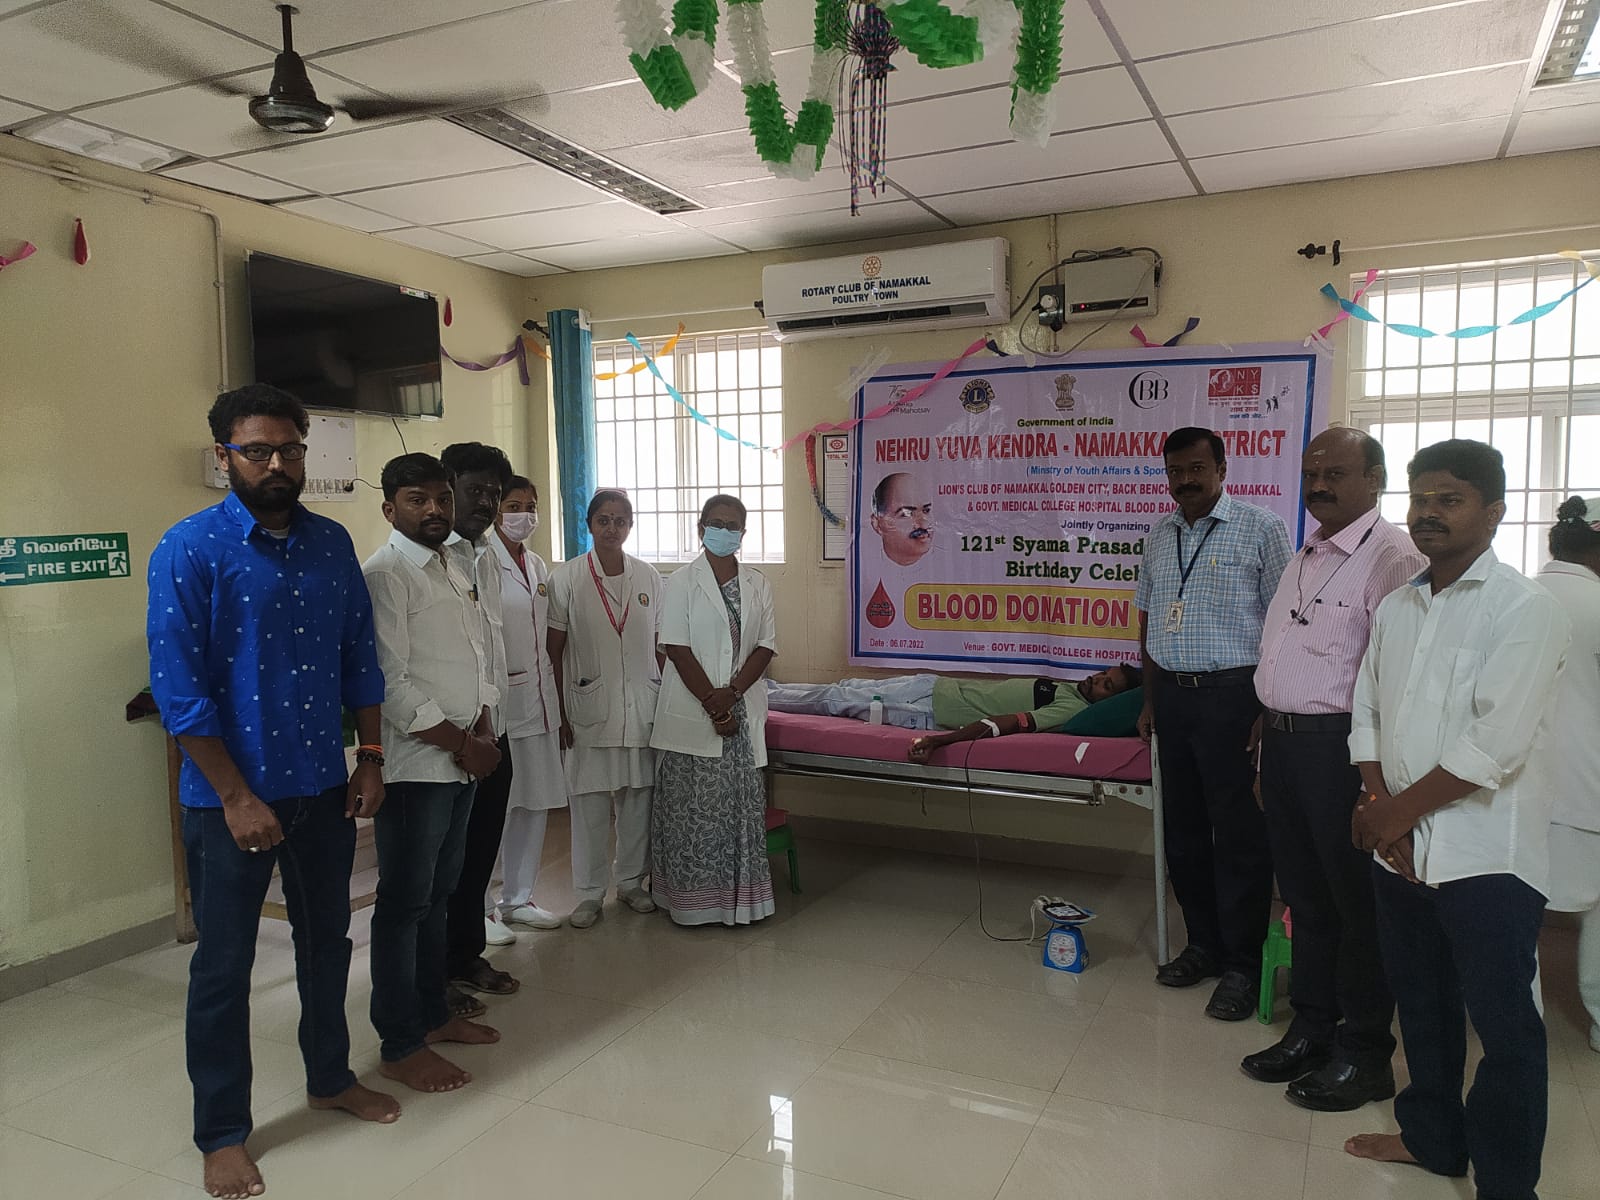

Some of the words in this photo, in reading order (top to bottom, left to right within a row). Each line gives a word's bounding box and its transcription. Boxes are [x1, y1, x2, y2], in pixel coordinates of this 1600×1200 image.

[801, 286, 836, 298] ROTARY
[837, 282, 861, 294] CLUB
[879, 276, 931, 290] NAMAKKAL
[832, 293, 869, 305] POULTRY
[873, 291, 899, 300] TOWN
[1017, 418, 1074, 427] Government
[1077, 417, 1087, 426] of
[1089, 416, 1114, 426] India
[876, 437, 930, 462] NEHRU
[935, 436, 982, 460] YUVA
[987, 432, 1058, 459] KENDRA
[1074, 431, 1168, 457] NAMAKKA
[1064, 466, 1073, 475] of
[1075, 466, 1100, 475] Youth
[1102, 466, 1131, 475] Affairs
[1134, 466, 1140, 475] &
[938, 484, 964, 495] LION'S
[967, 484, 988, 495] CLUB
[990, 484, 1001, 494] OF
[1004, 483, 1049, 494] NAMAKKAL
[1050, 483, 1085, 493] GOLDEN
[1087, 483, 1110, 496] CITY,
[1112, 484, 1136, 494] BACK
[1226, 484, 1282, 496] NAMAKKAL
[967, 501, 973, 511] &
[975, 501, 999, 511] GOVT.
[1001, 501, 1039, 511] MEDICAL
[1041, 501, 1075, 511] COLLEGE
[1078, 502, 1122, 512] HOSPITAL
[1125, 502, 1156, 513] BLOOD
[1061, 520, 1094, 531] Jointly
[1096, 521, 1150, 533] Organizing
[23, 537, 118, 554] வெளியே
[1013, 536, 1070, 556] Syama
[1077, 537, 1145, 555] Prasad
[28, 562, 66, 576] FIRE
[71, 559, 107, 573] EXIT
[1005, 561, 1082, 583] Birthday
[918, 593, 997, 620] BLOOD
[1006, 595, 1129, 627] DONATION
[870, 639, 884, 647] Date
[890, 640, 924, 648] 06.07.2022
[964, 642, 985, 651] Venue
[991, 643, 1016, 652] GOVT.
[1053, 647, 1092, 658] COLLEGE
[1095, 650, 1141, 661] HOSPITAL
